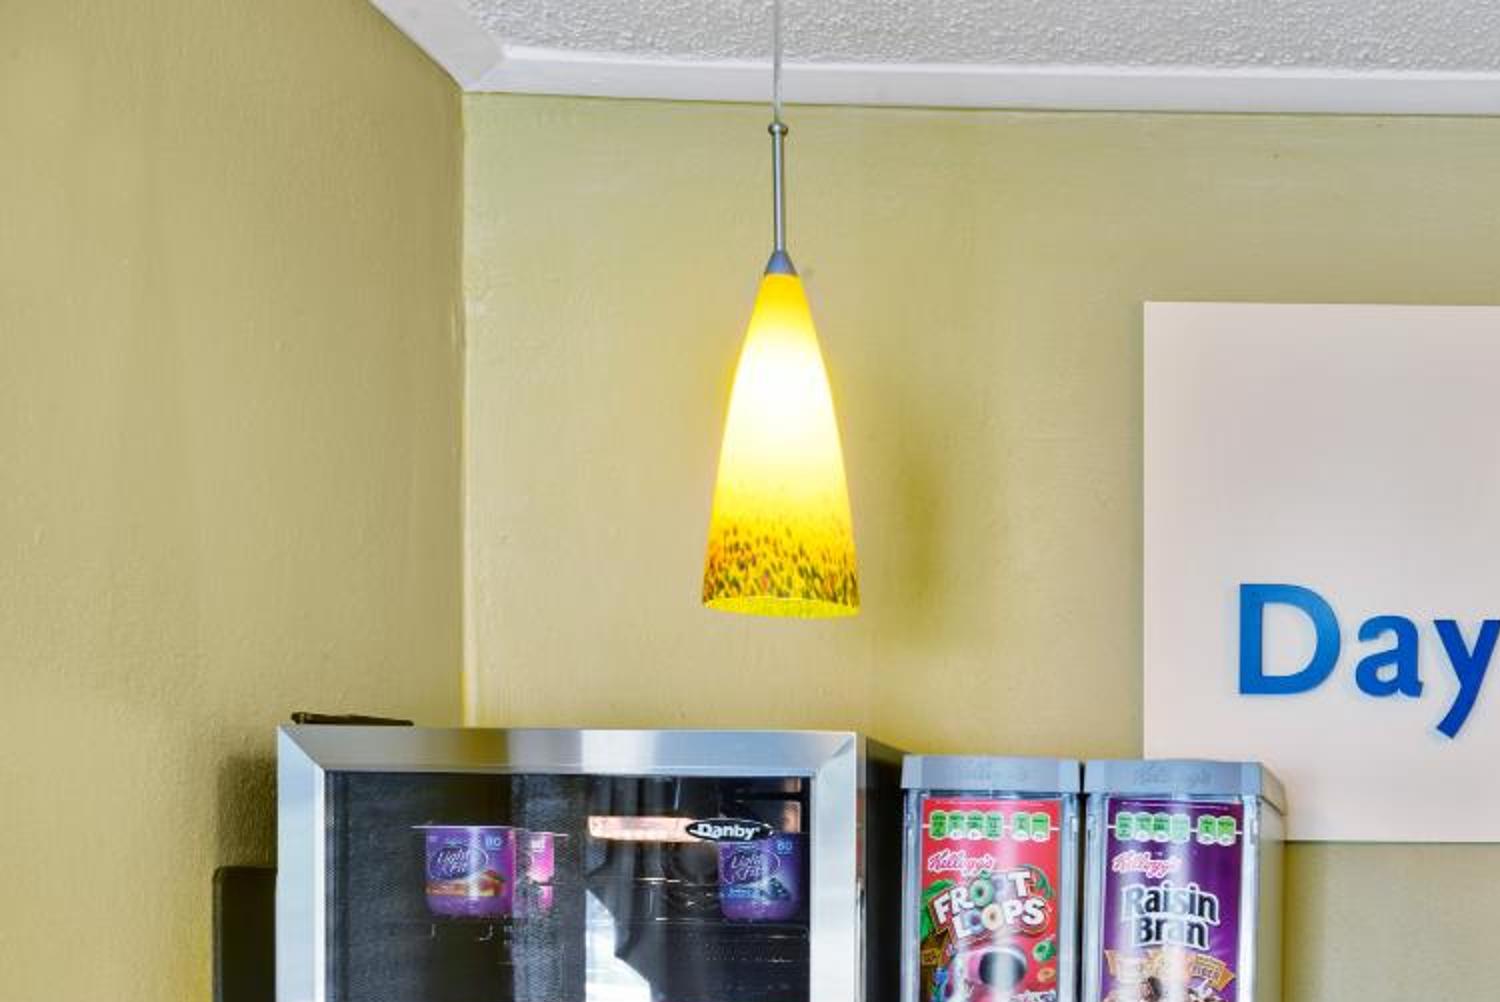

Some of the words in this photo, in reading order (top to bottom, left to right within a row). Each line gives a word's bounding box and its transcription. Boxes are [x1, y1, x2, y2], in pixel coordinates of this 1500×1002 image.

[691, 823, 756, 841] Danby
[928, 850, 994, 877] Kellogg's
[951, 896, 1047, 939] LOOPS
[1124, 883, 1219, 923] Raisin
[1135, 915, 1208, 949] Bran
